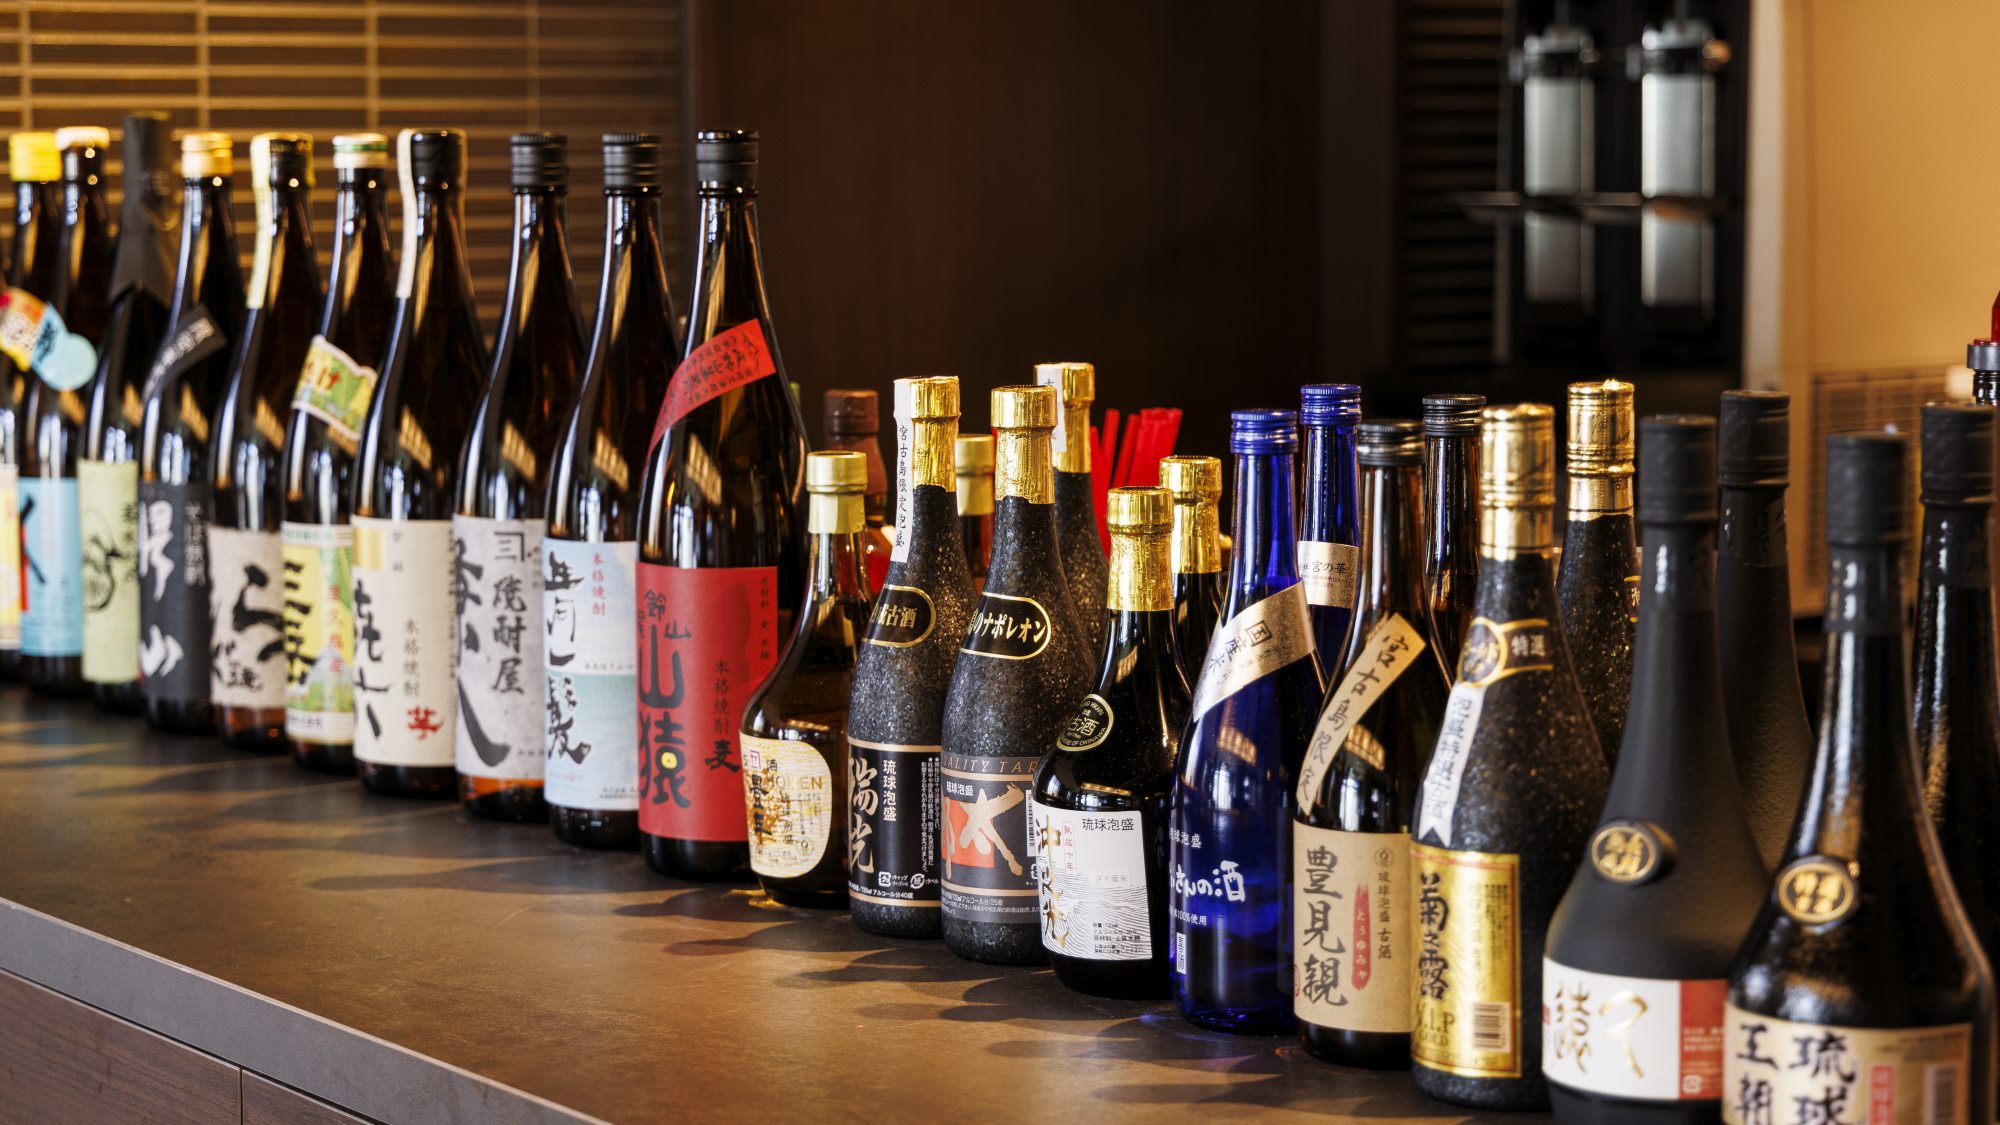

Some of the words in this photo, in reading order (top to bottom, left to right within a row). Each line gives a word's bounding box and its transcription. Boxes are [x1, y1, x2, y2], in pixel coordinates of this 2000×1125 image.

[896, 425, 909, 548] 宮古島限定泡盛
[592, 552, 606, 617] 本格焼酎
[1312, 560, 1347, 576] 宮の華
[404, 617, 421, 697] 本格焼酎
[493, 574, 527, 695] 焼酎屋
[1208, 619, 1272, 673] 国産米
[638, 623, 692, 808] 山猿
[713, 657, 732, 734] 本格焼酎
[1299, 635, 1409, 801] 宮古島限定
[407, 706, 444, 741] 芋
[1068, 715, 1100, 736] 古酒
[704, 738, 741, 772] 麦
[942, 755, 991, 773] UALITY
[1000, 760, 1039, 774] TAR
[883, 759, 897, 822] 琉球泡盛
[946, 781, 974, 797] 琉球泡盛
[1063, 825, 1075, 872] 熟成十年
[1082, 818, 1134, 831] 琉球泡盛
[1169, 827, 1202, 849] 球泡盛
[1169, 859, 1246, 902] さんの酒
[1377, 871, 1392, 922] 琉球泡盛
[1377, 928, 1392, 960] 古酒
[1418, 872, 1450, 1000] 菊之露
